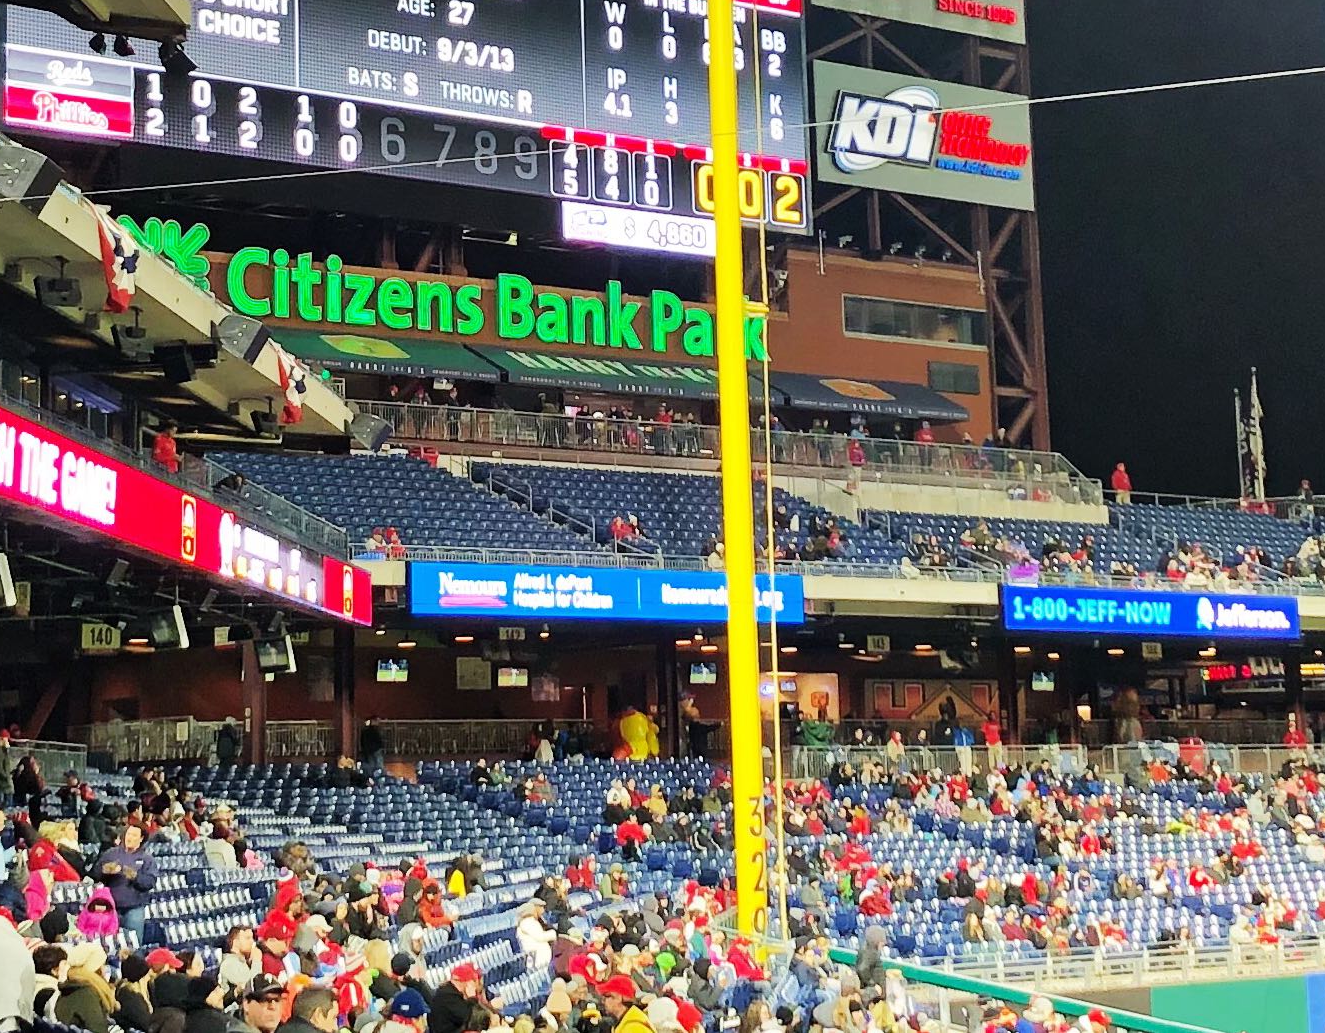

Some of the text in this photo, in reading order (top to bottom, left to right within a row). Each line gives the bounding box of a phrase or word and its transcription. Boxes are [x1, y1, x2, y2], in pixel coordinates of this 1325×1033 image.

[198, 9, 280, 44] CHOICE
[448, 0, 474, 25] 27
[604, 0, 627, 25] W
[663, 12, 674, 34] L
[761, 28, 786, 53] BB
[367, 29, 515, 72] DEBUT: 9/3/13
[768, 54, 781, 77] 2
[46, 60, 357, 129] Reds 0 2 1 0
[348, 67, 533, 114] BATS: S THROWS: R
[607, 67, 782, 116] IP H K
[603, 92, 784, 141] 4.1 3 6
[33, 91, 659, 206] Phillies 2 2 0 0 5 4 0
[775, 175, 801, 223] 2
[227, 246, 772, 363] Citizens Bank Pak
[18, 430, 60, 507] THE
[60, 451, 118, 526] GAME!
[438, 571, 508, 597] Nemours
[1012, 595, 1172, 626] 1-800-JEFF-NOW
[89, 626, 113, 646] 140
